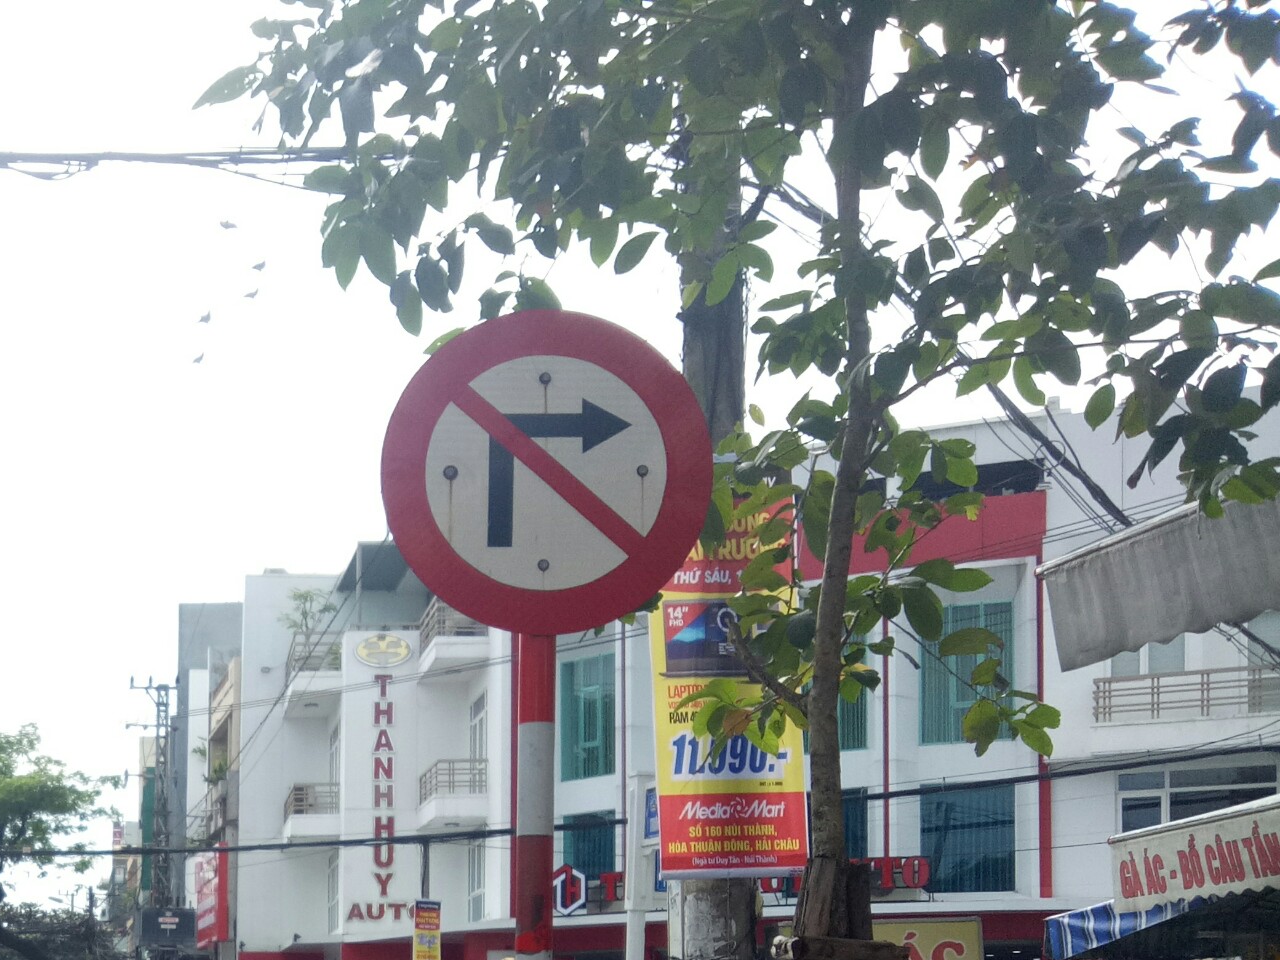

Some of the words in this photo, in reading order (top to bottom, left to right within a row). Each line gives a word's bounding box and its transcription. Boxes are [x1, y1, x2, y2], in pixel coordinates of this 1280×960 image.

[704, 567, 732, 585] SÁU,
[688, 822, 702, 838] SỐ
[706, 825, 722, 838] 160
[725, 823, 740, 837] NÚI
[1120, 851, 1145, 899] GÀ
[1144, 848, 1167, 896] ÁC
[1204, 834, 1246, 886] CÂU
